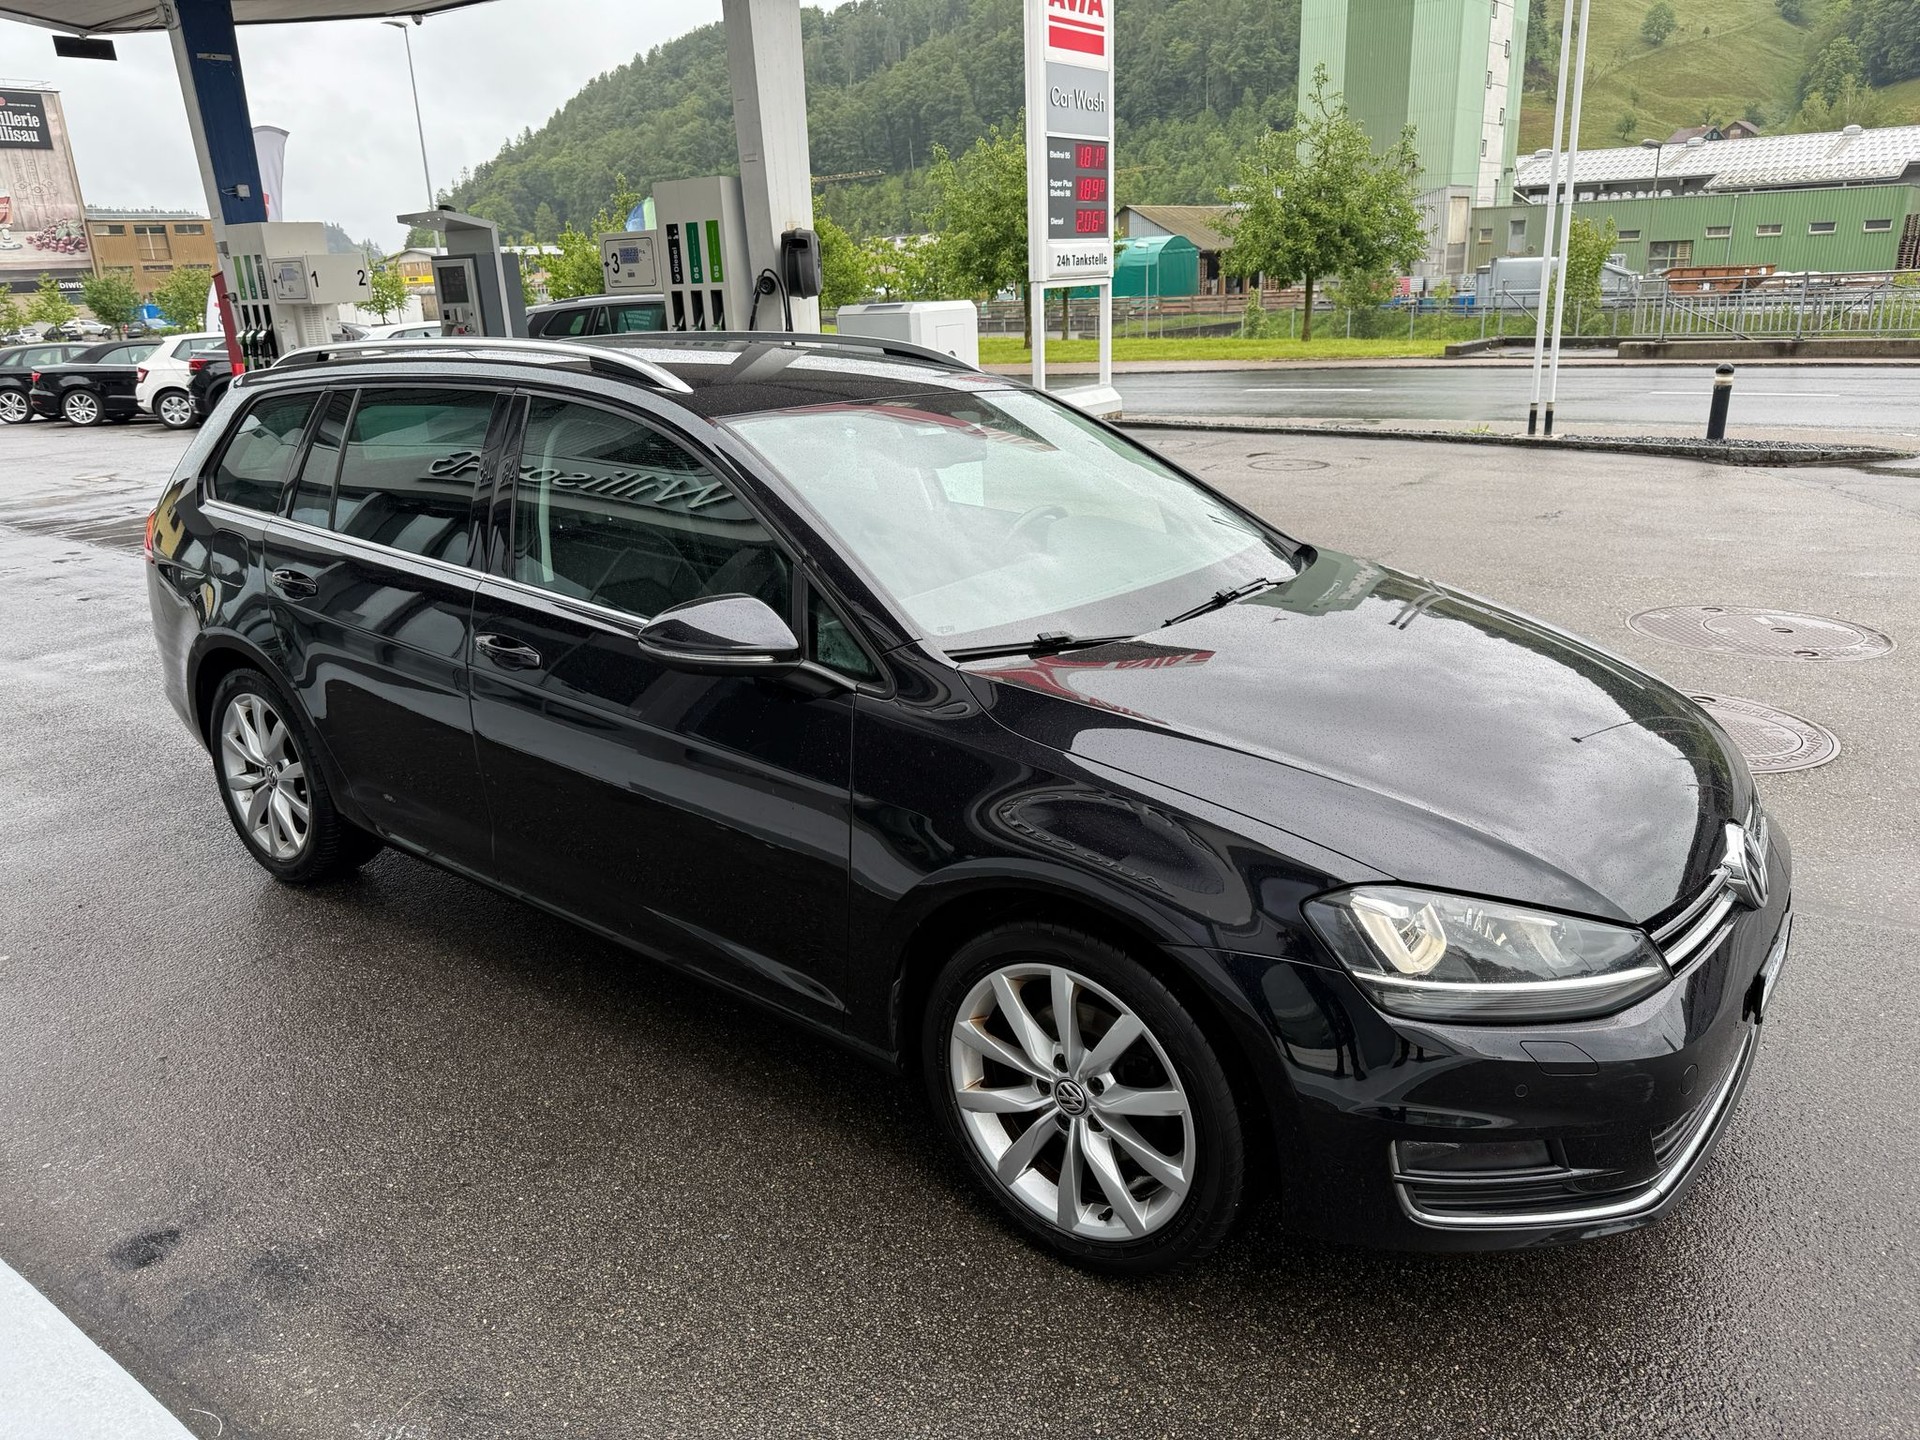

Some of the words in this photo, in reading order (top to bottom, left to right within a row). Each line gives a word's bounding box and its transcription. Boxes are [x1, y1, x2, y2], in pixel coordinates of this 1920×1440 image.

[1051, 86, 1072, 108] Car
[1074, 88, 1106, 112] Wash
[1050, 179, 1063, 188] Super
[1063, 179, 1073, 187] Plus
[1050, 217, 1064, 225] Diesel
[611, 253, 620, 274] 3
[1057, 255, 1070, 267] 24h
[1072, 253, 1107, 266] Tankstelle
[311, 270, 319, 288] 1
[357, 269, 366, 286] 2
